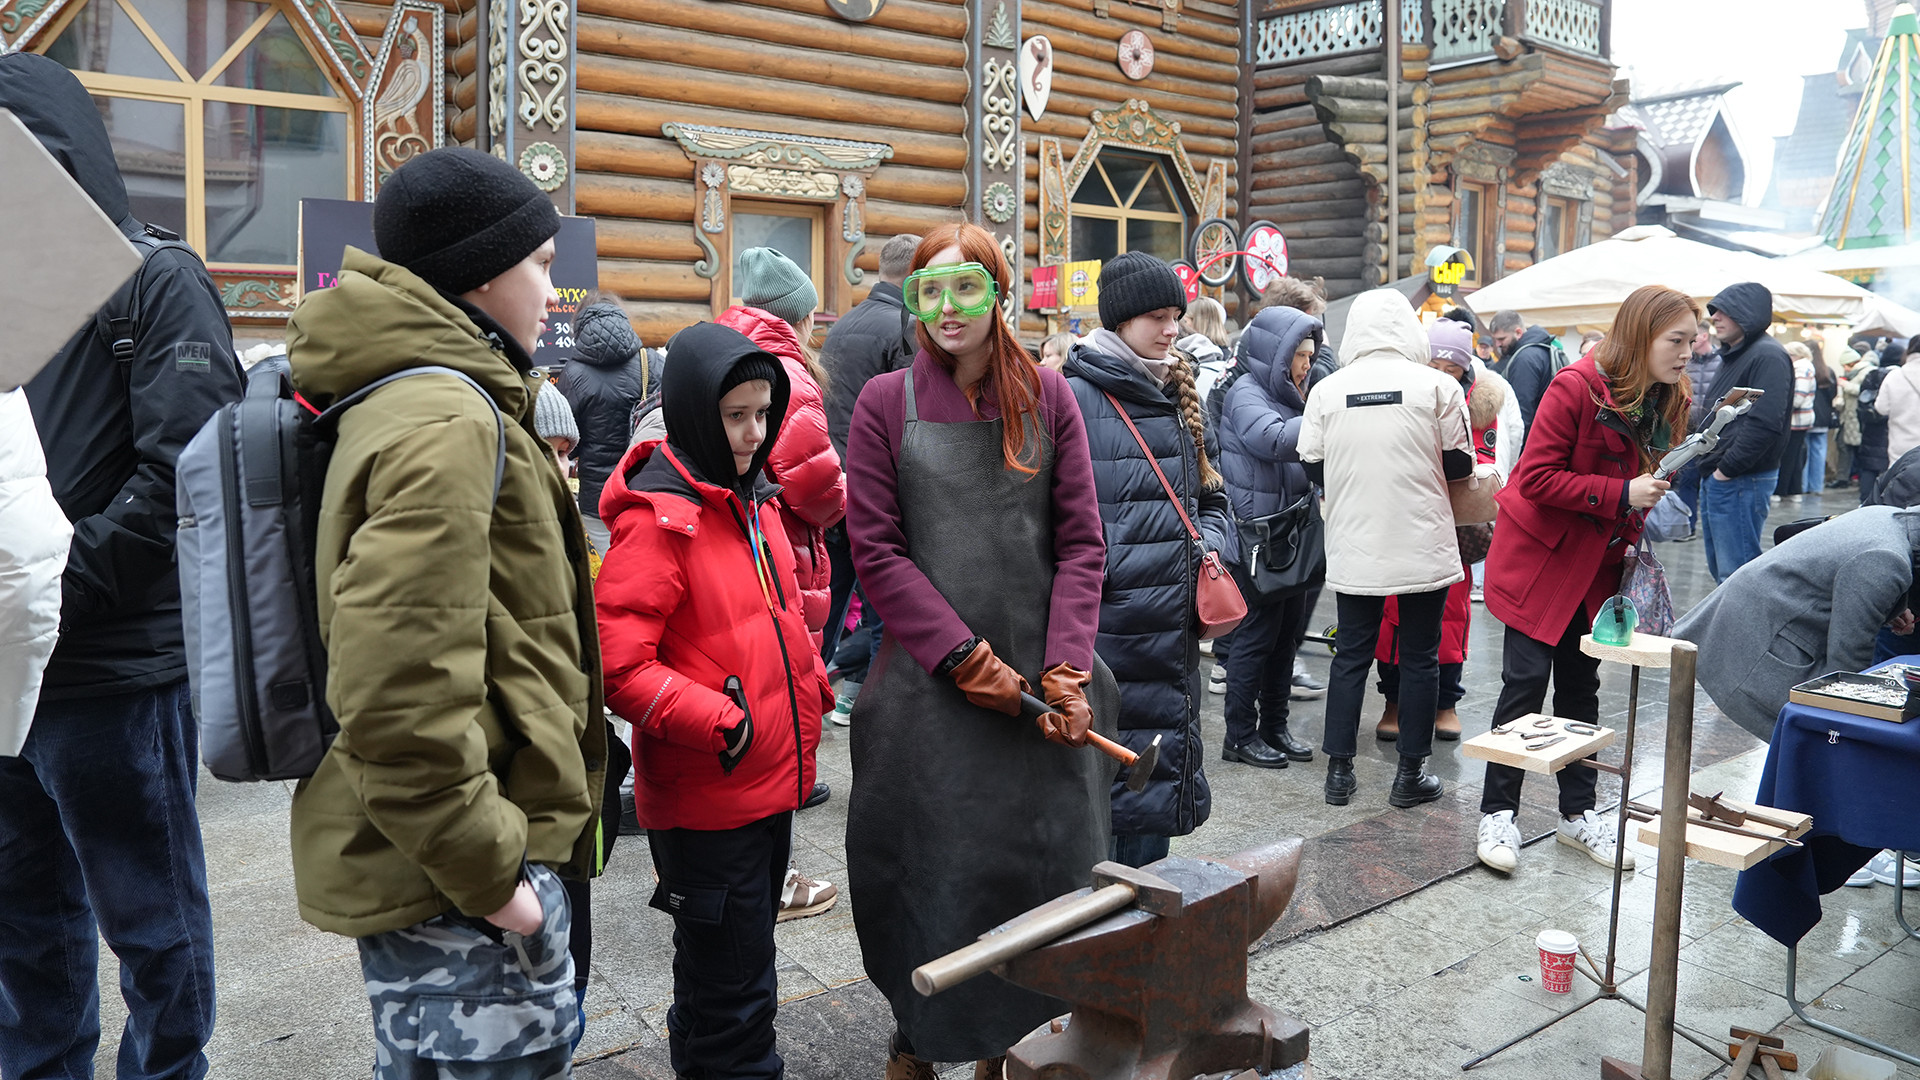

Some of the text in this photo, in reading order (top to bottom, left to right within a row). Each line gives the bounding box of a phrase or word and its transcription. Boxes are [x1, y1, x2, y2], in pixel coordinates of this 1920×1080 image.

[317, 272, 338, 288] Гл
[1434, 262, 1466, 285] СЫР
[177, 345, 209, 360] MEN
